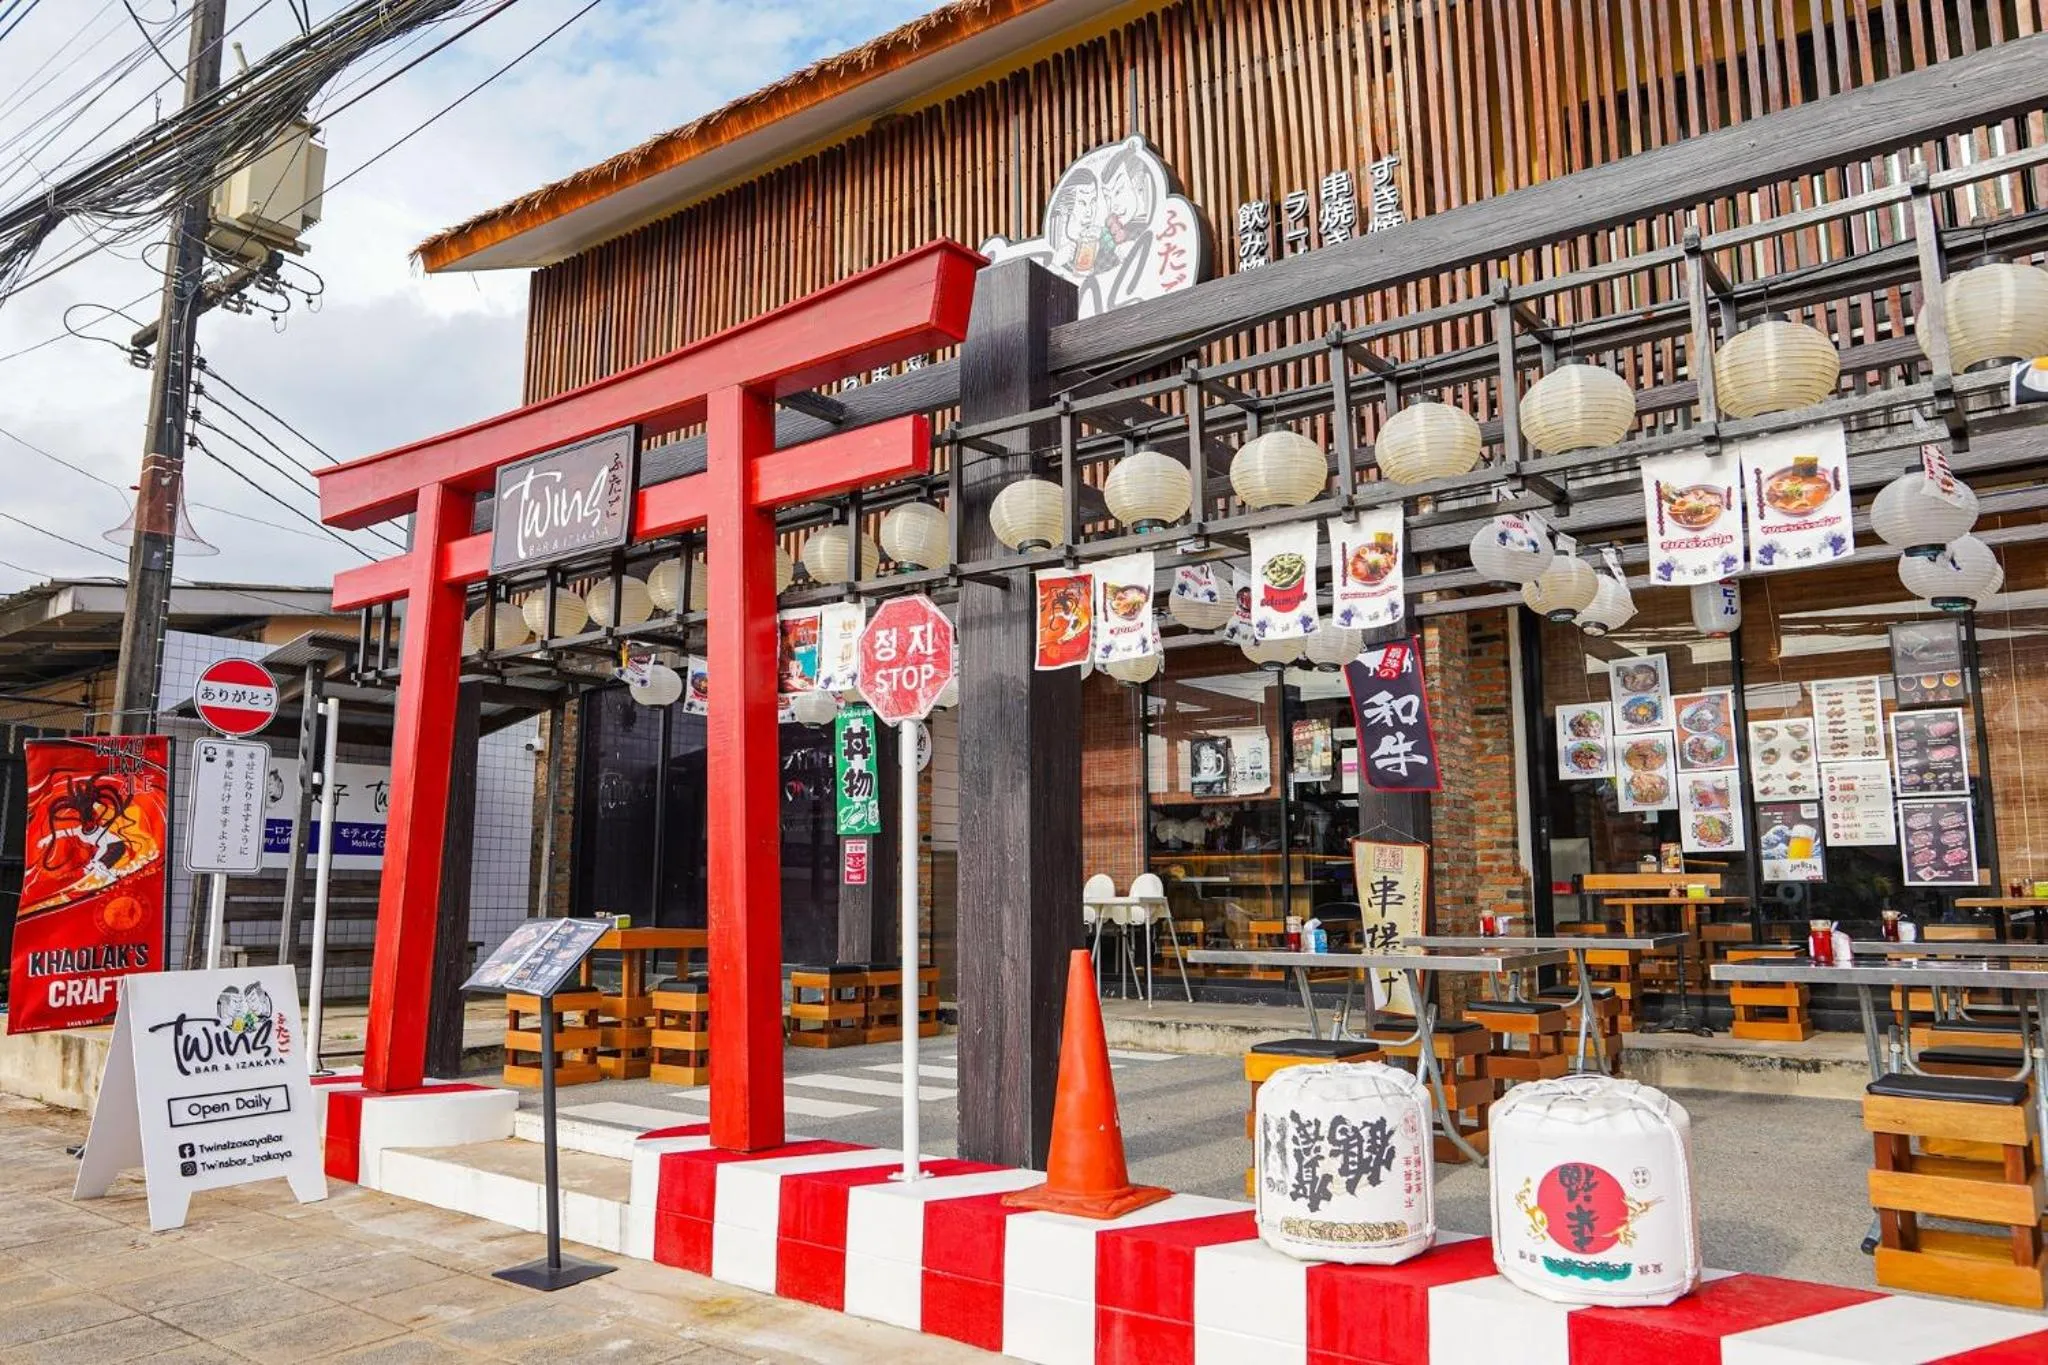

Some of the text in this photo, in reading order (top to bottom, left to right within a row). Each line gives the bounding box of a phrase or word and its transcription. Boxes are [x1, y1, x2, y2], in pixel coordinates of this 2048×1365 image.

[503, 466, 609, 559] Twins
[875, 663, 935, 693] STOP
[201, 686, 273, 707] ありがとう
[1362, 690, 1428, 776] 和牛
[841, 724, 875, 799] 丼物
[28, 943, 149, 978] KHAOLAK'S
[148, 1013, 273, 1076] Twins
[195, 1065, 219, 1075] BAR
[236, 1058, 285, 1070] IZAKAYA
[187, 1093, 272, 1119] Open Daily
